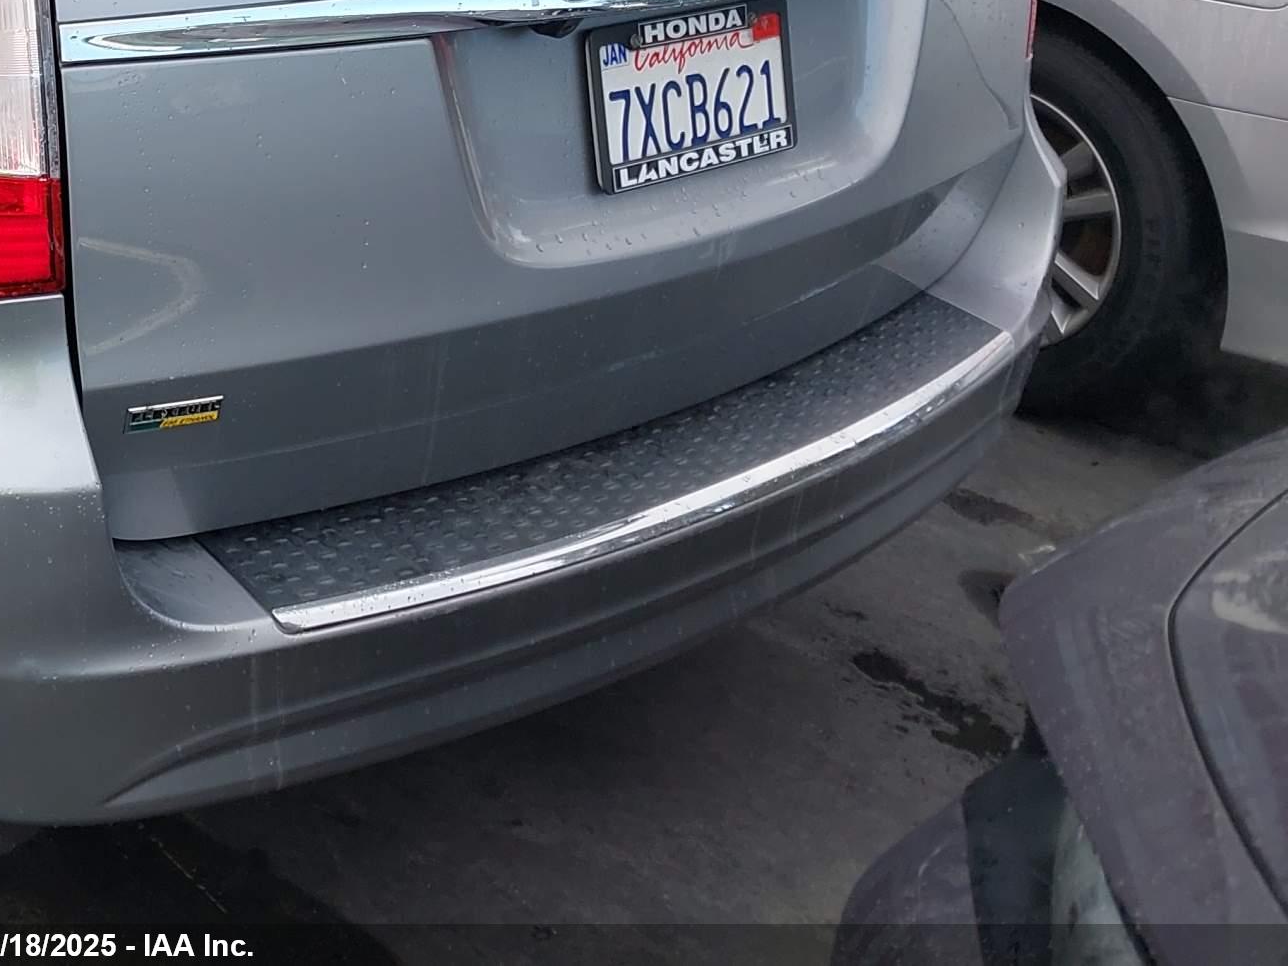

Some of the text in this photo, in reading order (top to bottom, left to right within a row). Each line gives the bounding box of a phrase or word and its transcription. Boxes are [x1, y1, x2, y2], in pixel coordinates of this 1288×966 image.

[643, 9, 743, 44] HONDA
[602, 32, 754, 74] JAN California
[608, 60, 782, 164] 7XCB621
[619, 129, 789, 188] LANCASTER
